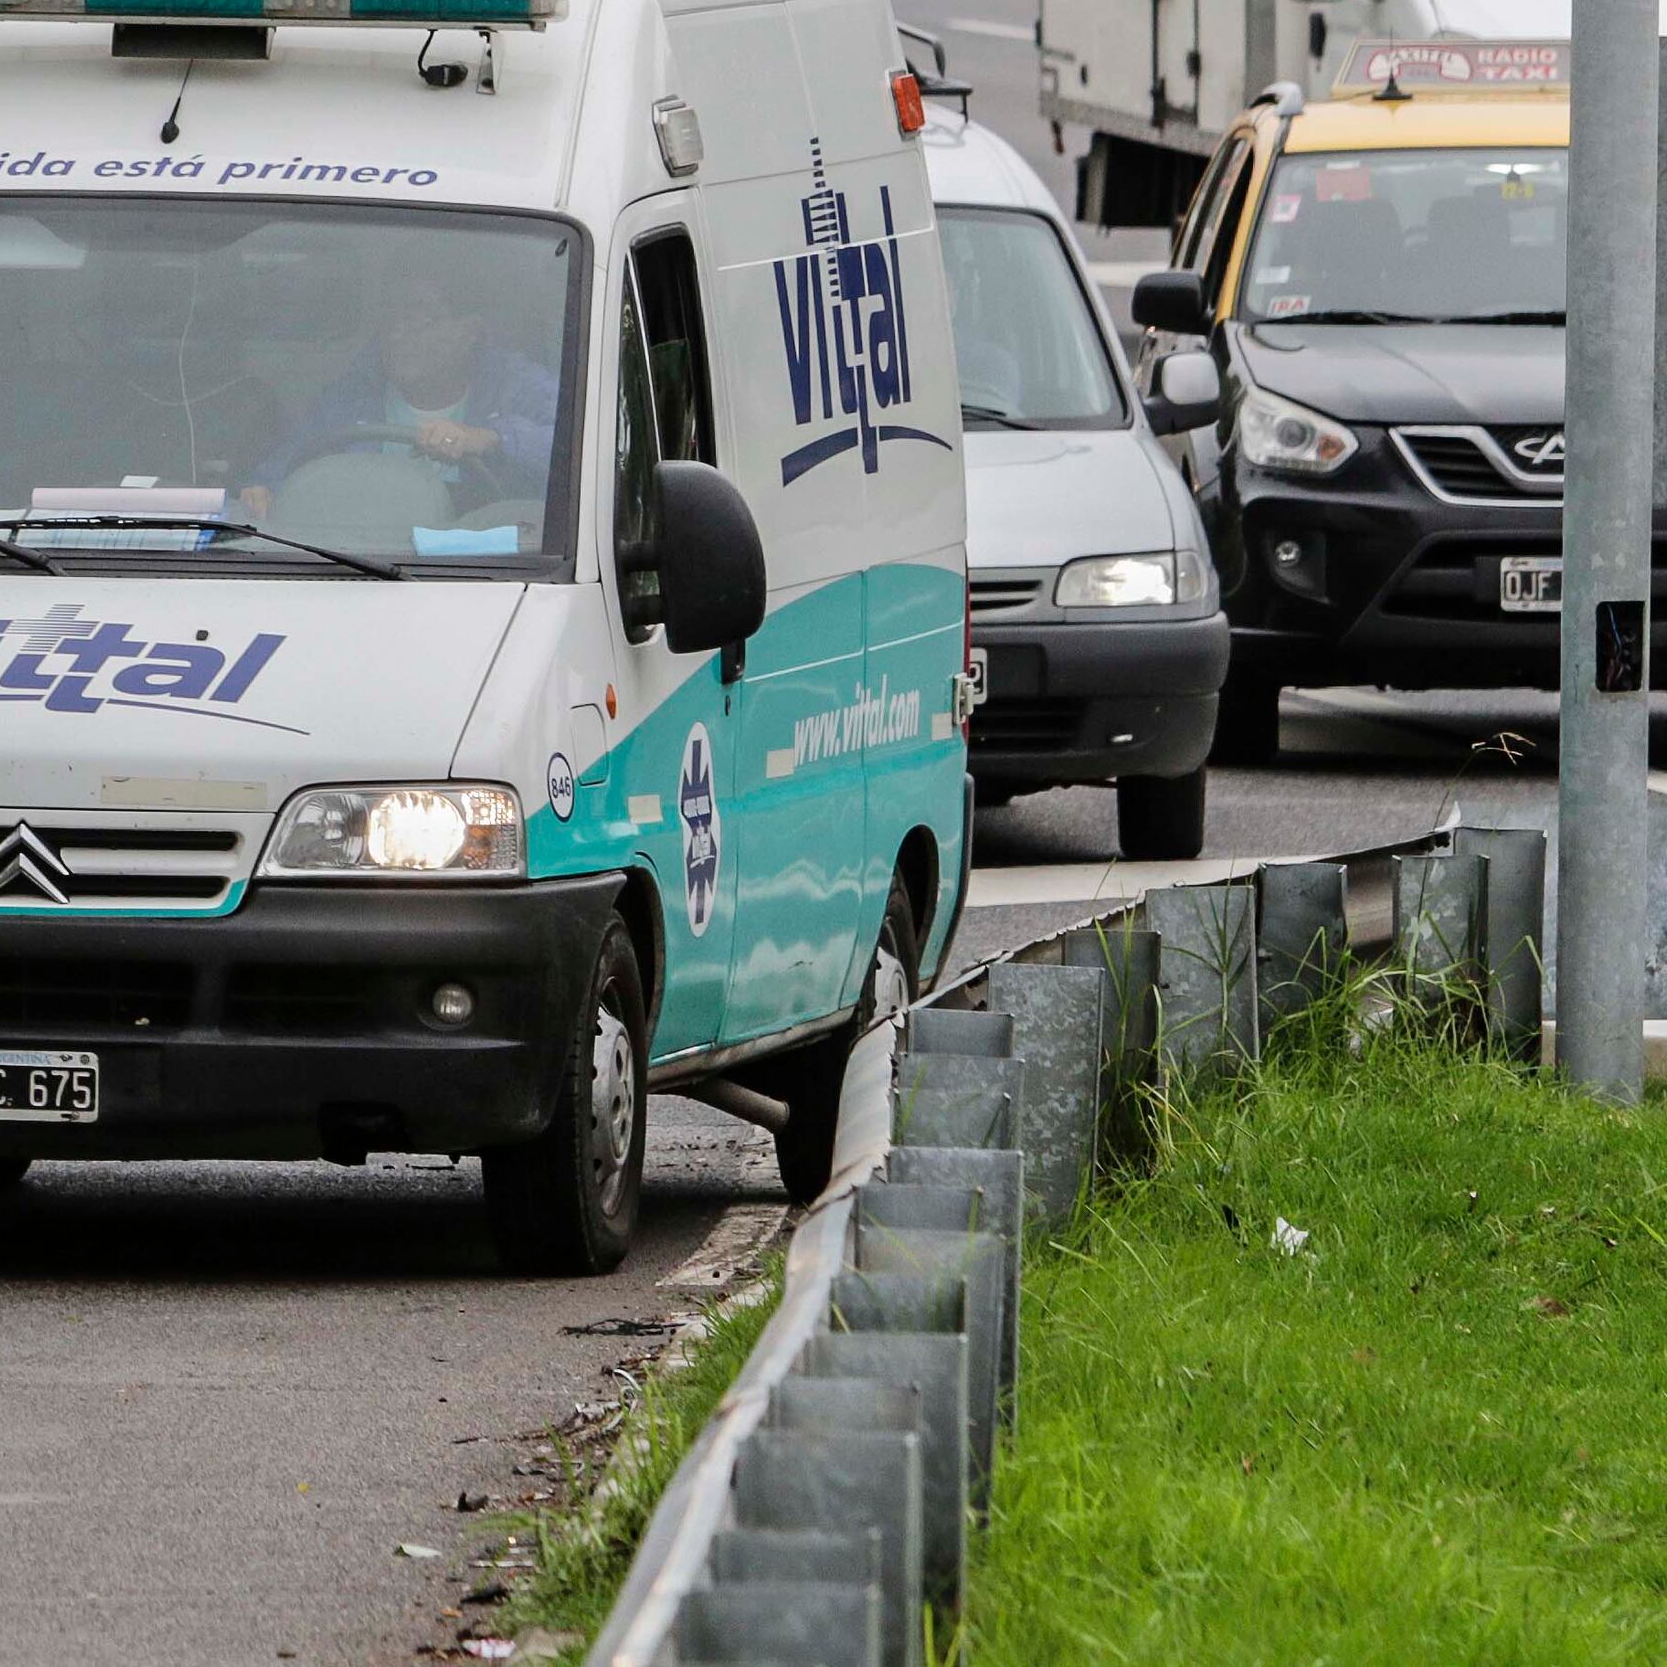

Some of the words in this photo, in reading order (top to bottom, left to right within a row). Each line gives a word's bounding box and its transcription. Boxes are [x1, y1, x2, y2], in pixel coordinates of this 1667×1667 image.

[1477, 48, 1558, 65] RADIO
[1483, 65, 1558, 81] TAXI
[94, 153, 202, 182] está
[218, 157, 440, 190] primero
[1505, 571, 1553, 602] OJF
[793, 673, 921, 768] www.vittal.com
[551, 775, 572, 799] 846
[29, 1069, 92, 1109] 675
